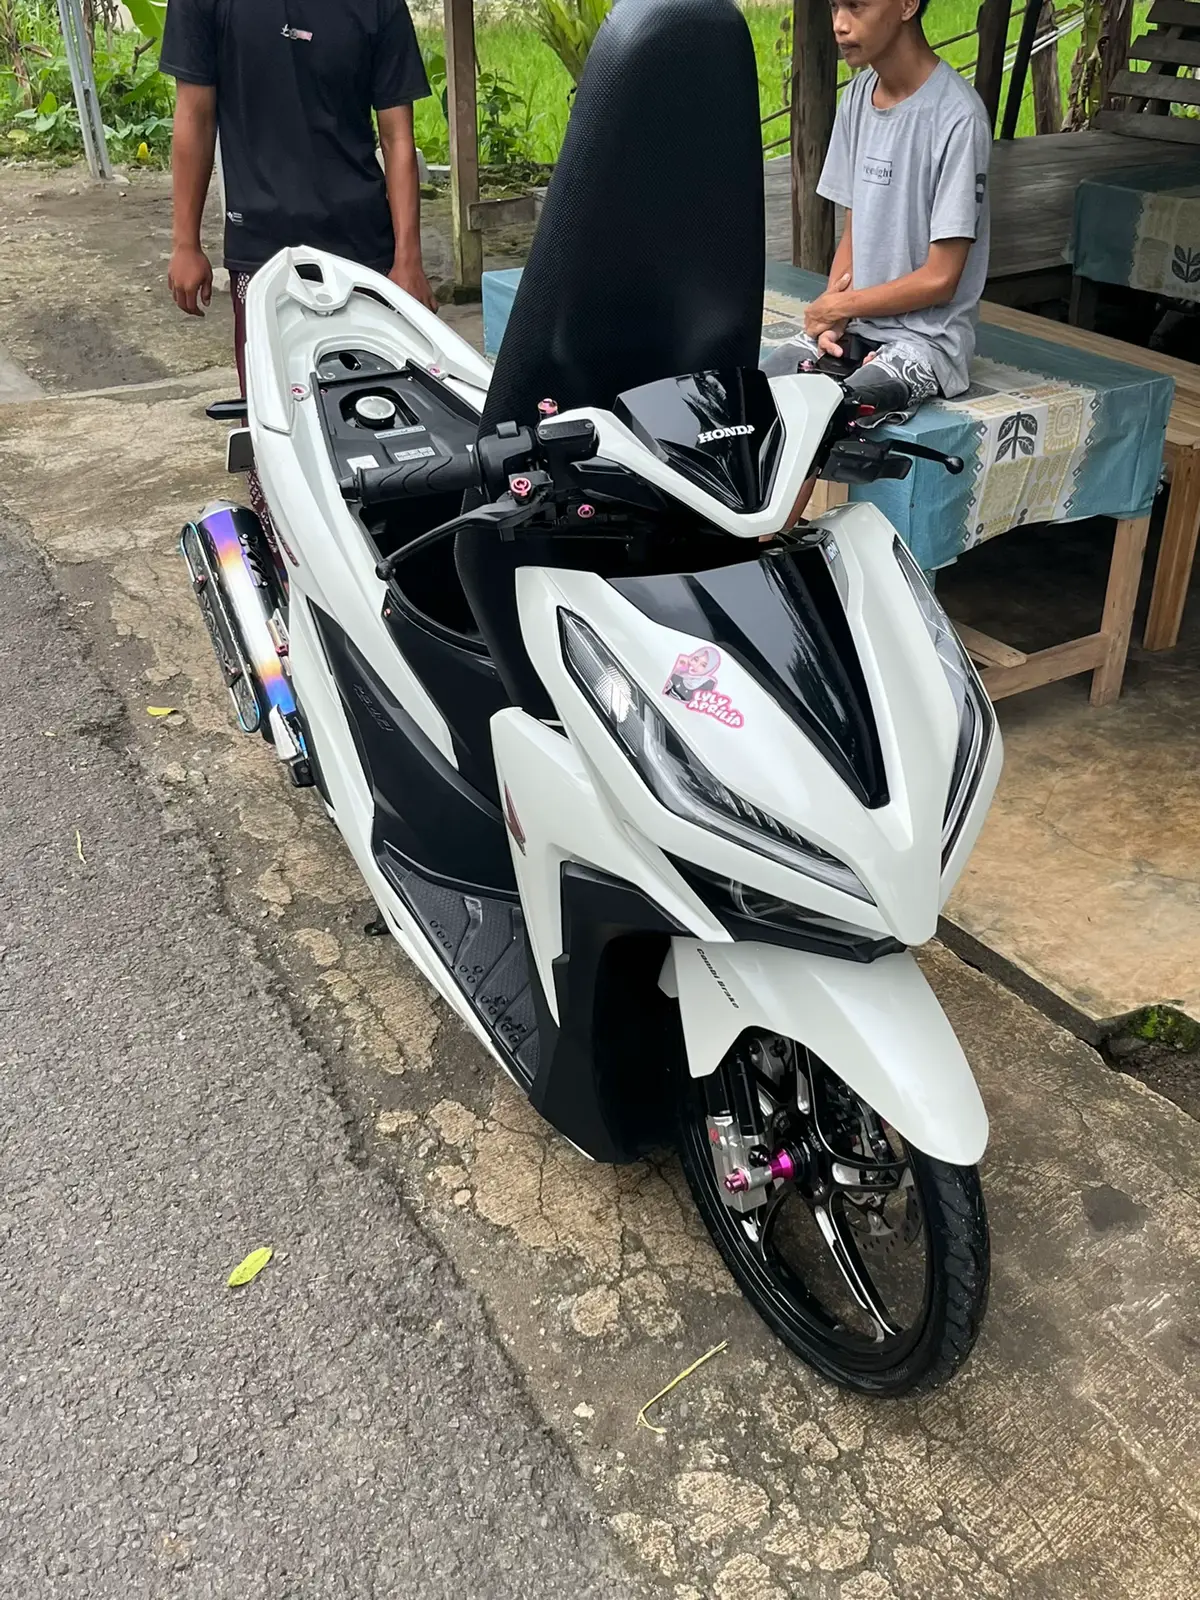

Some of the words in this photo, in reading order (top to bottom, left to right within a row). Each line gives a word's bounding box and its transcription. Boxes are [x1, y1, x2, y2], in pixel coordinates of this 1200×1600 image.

[697, 425, 755, 444] HONDA
[694, 691, 728, 706] LYLY
[717, 980, 740, 1009] Brake
